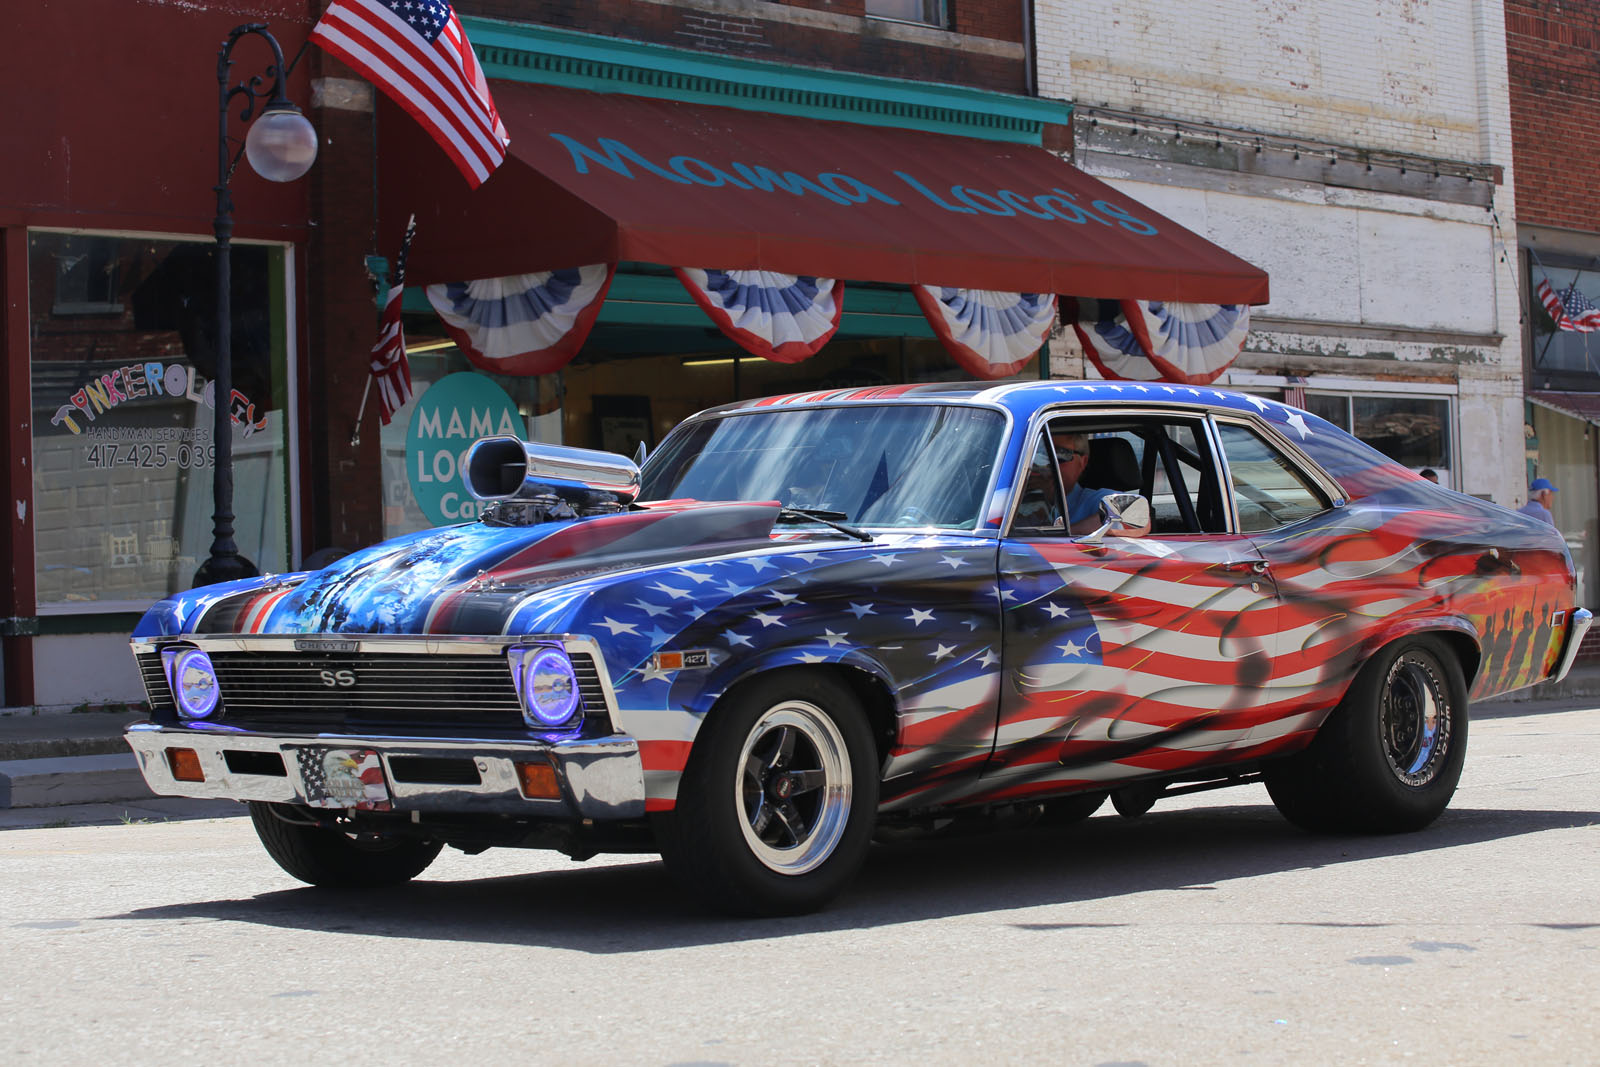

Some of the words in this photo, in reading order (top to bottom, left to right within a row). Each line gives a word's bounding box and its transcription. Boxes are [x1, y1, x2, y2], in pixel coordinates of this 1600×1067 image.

[549, 132, 901, 206] Mama
[893, 170, 1158, 236] Loco's
[417, 406, 517, 438] MAMA
[86, 427, 153, 441] HANDYMAN
[156, 427, 209, 441] SERVICES
[86, 443, 234, 469] 417-425-039
[299, 641, 337, 650] CHEVY
[684, 654, 706, 664] 427
[320, 670, 356, 687] SS
[1441, 705, 1451, 755] WELD
[1399, 771, 1435, 787] RACING
